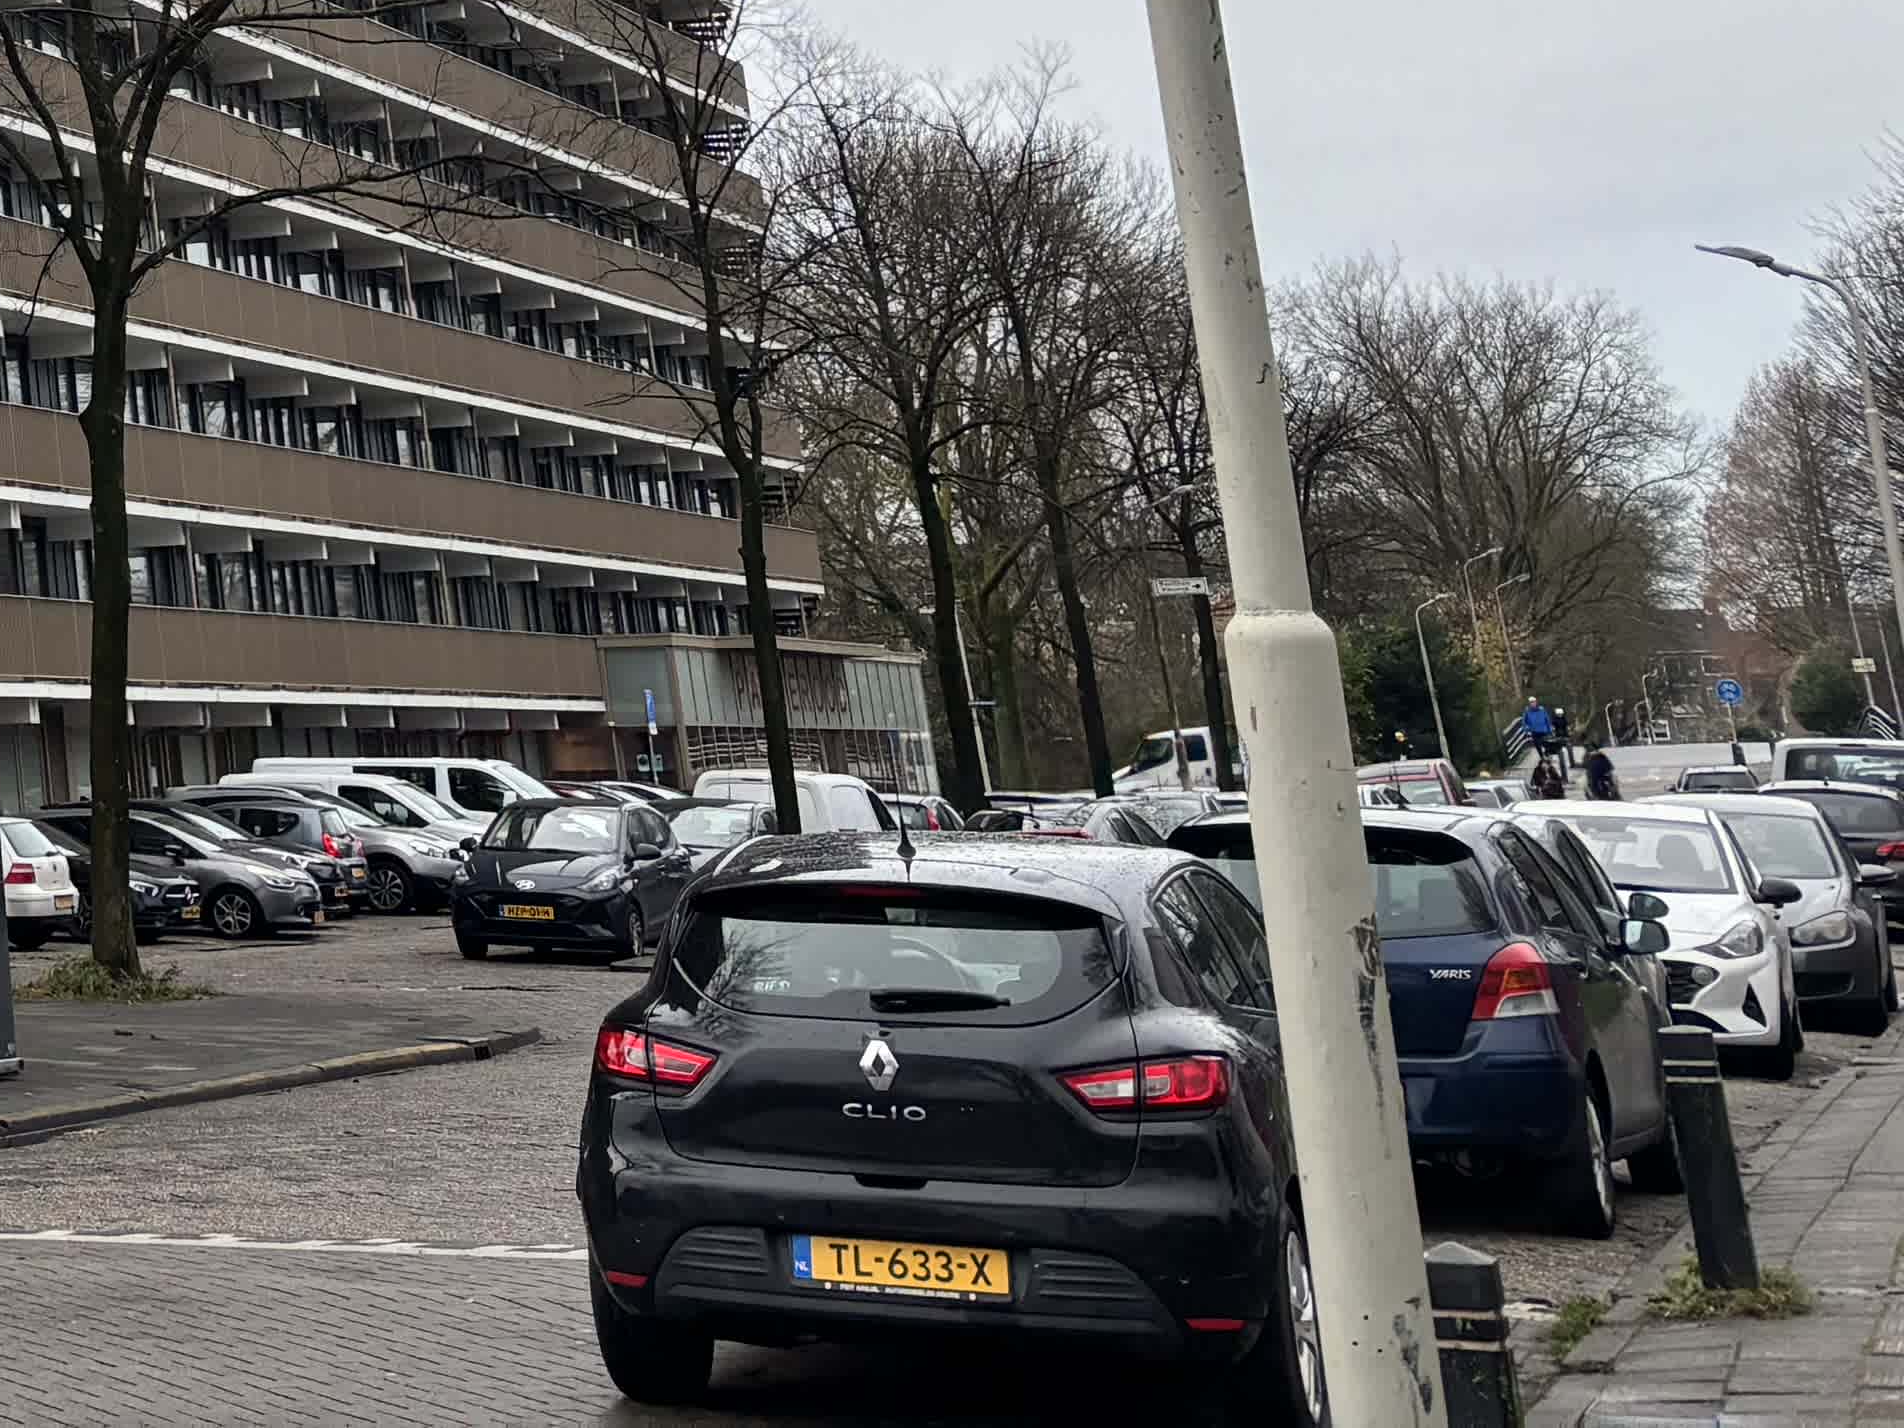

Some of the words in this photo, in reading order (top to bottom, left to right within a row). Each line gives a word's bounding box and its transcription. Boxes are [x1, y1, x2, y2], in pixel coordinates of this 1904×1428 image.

[1429, 968, 1472, 980] YARIS
[842, 1102, 927, 1121] CLIO
[794, 1261, 809, 1273] NL
[829, 1243, 993, 1287] TL-633-X
